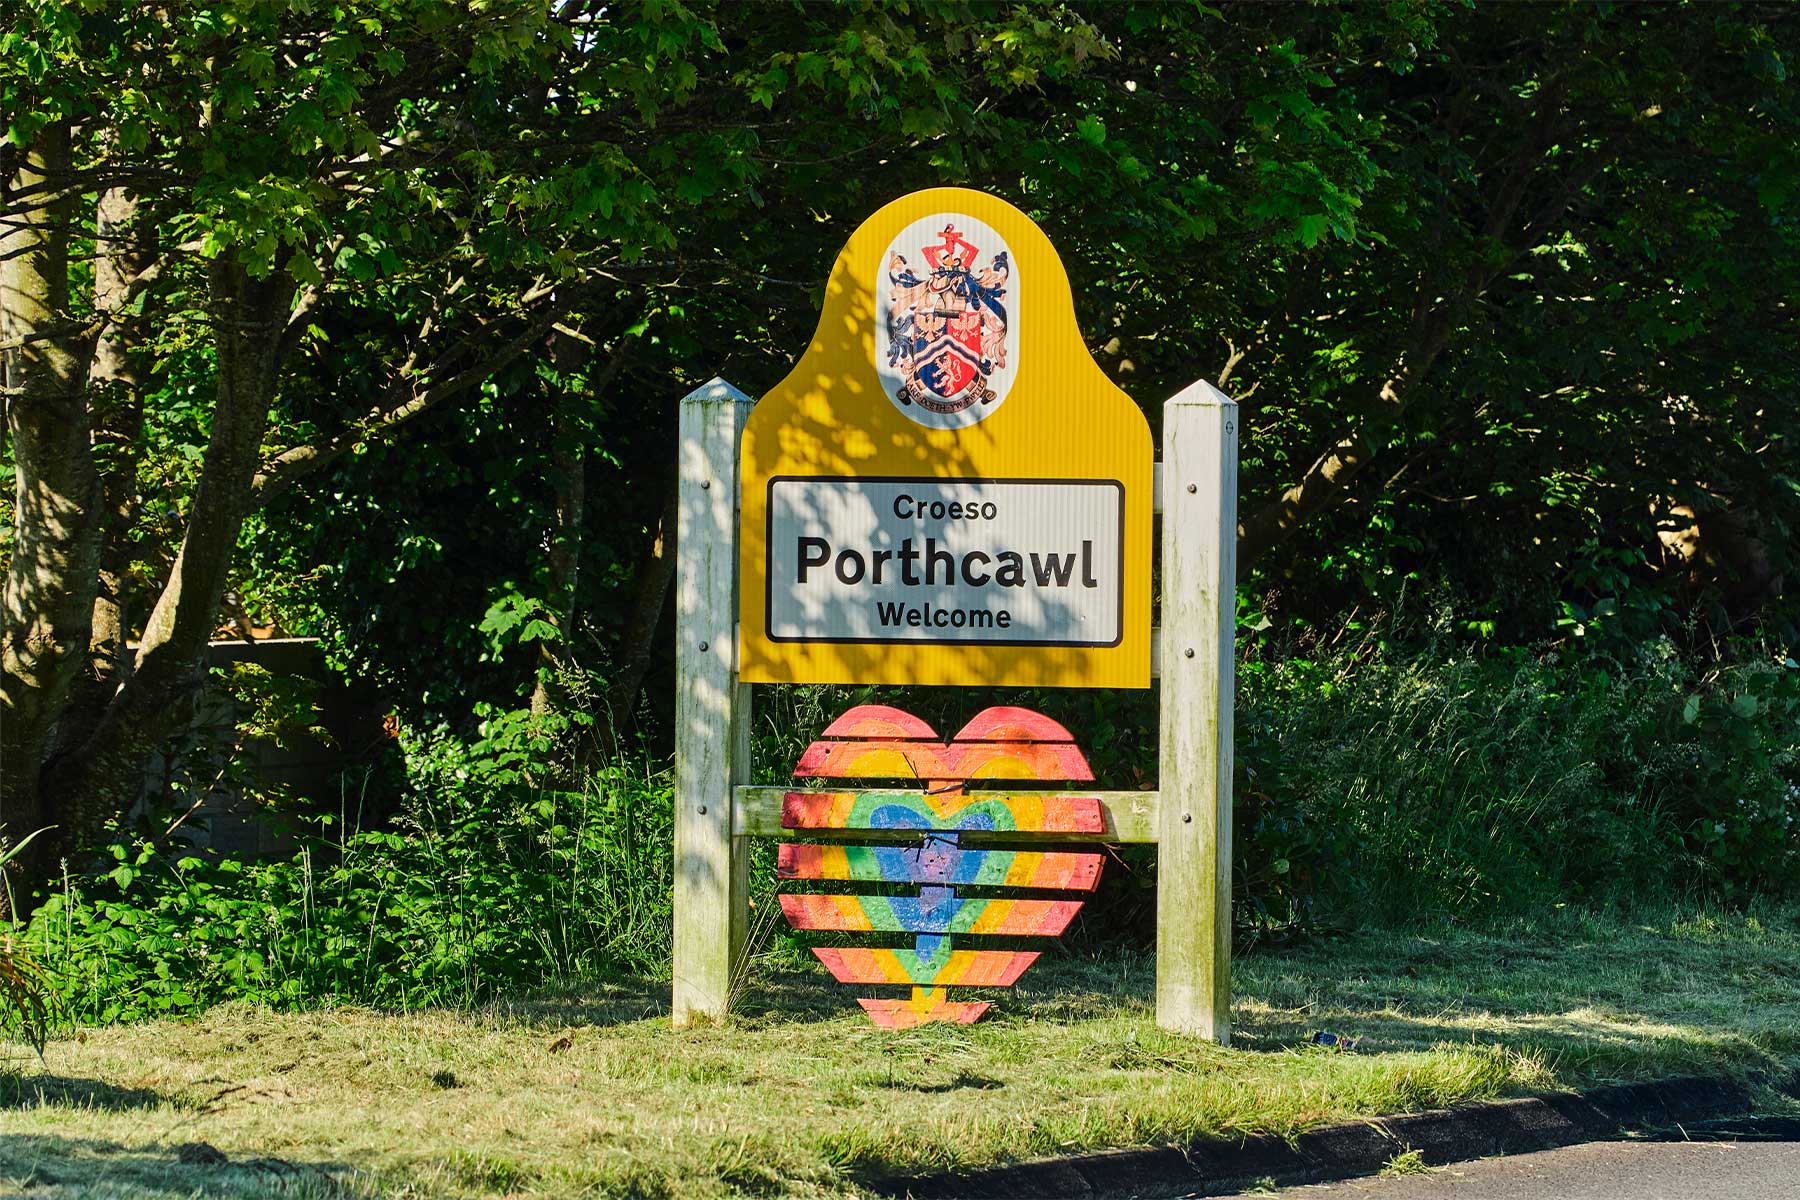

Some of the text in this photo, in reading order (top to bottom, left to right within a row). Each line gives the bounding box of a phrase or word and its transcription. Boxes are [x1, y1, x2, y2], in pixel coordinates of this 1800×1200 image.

[893, 494, 998, 520] Croeso
[797, 536, 1098, 588] Porthcawl
[877, 601, 1011, 628] Welcome
